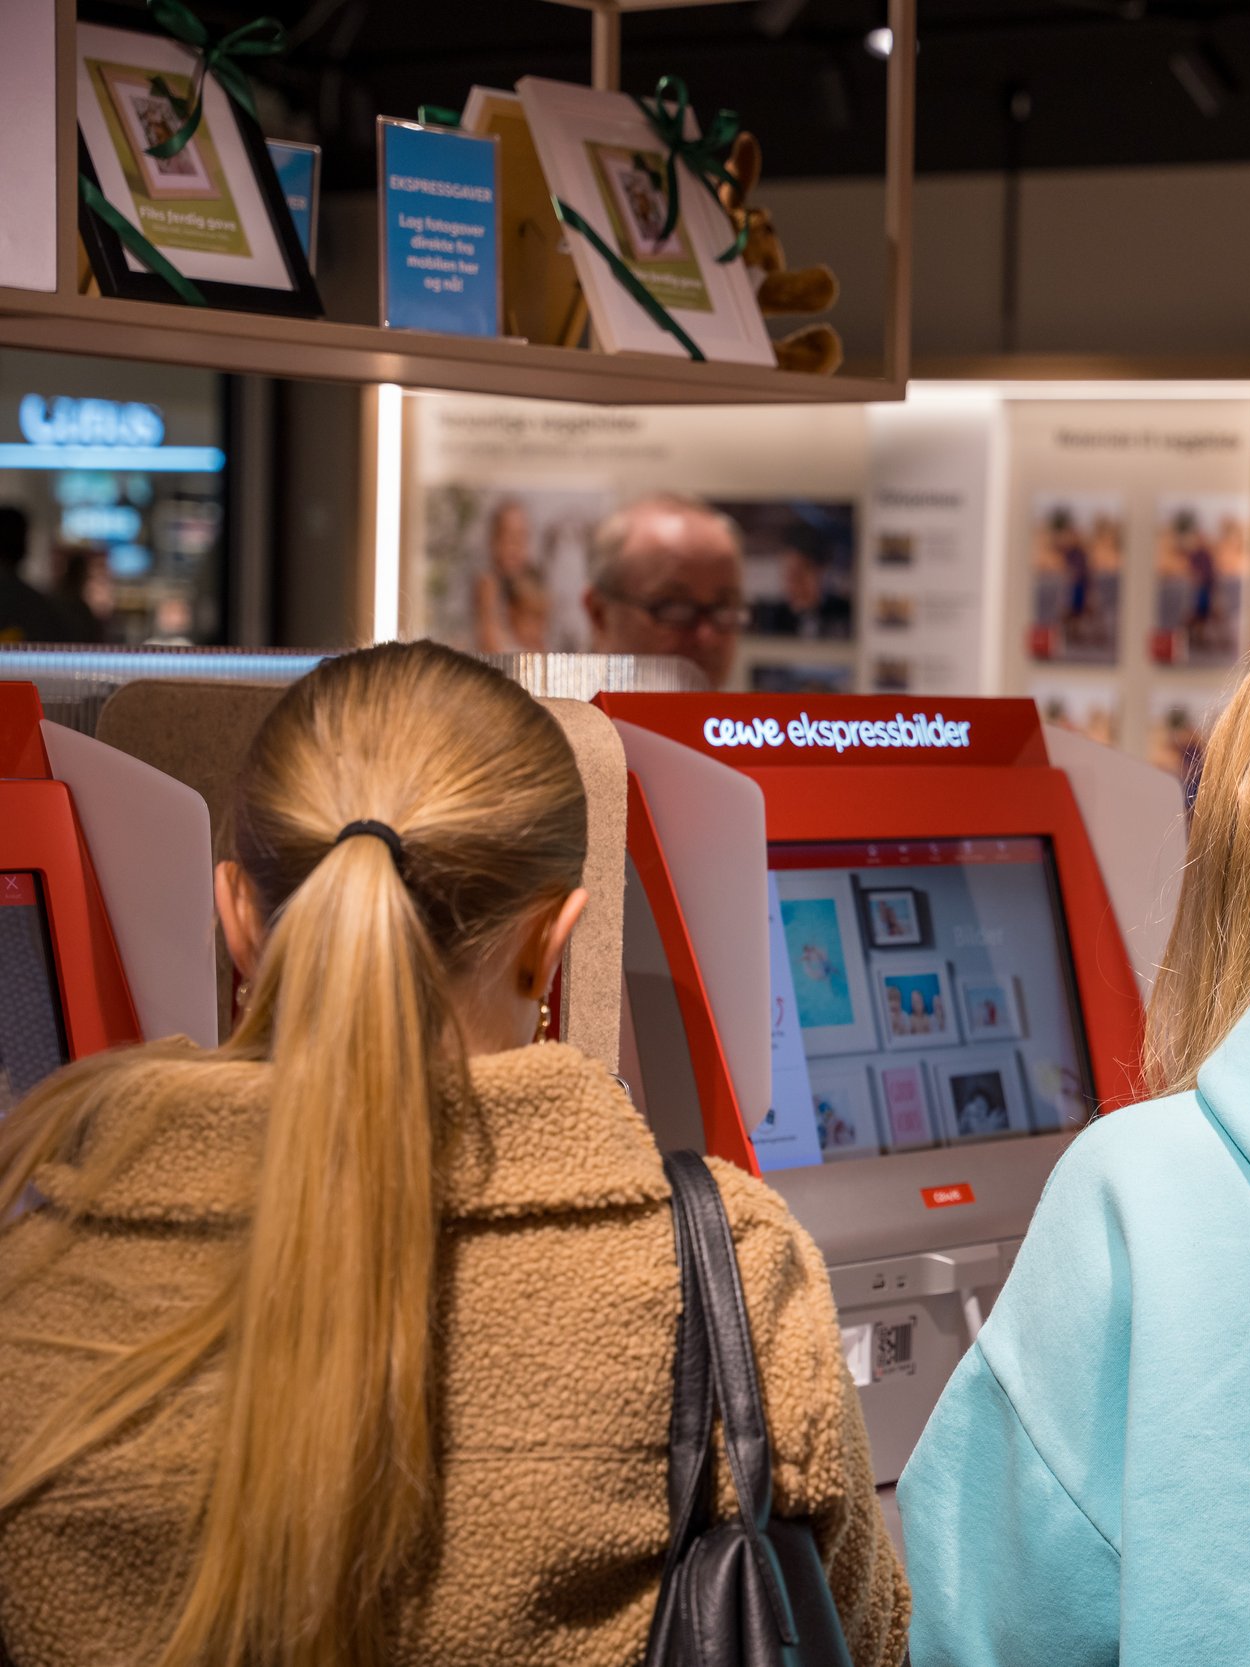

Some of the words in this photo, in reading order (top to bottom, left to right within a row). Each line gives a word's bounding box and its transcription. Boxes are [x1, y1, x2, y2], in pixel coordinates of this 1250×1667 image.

[389, 174, 493, 203] EKSPRESSGAVER
[399, 212, 423, 233] Lag
[425, 216, 486, 238] fotogaver
[410, 234, 454, 254] direkte
[456, 238, 475, 256] fra
[406, 255, 457, 272] mobilen
[458, 259, 479, 275] her
[423, 276, 441, 293] og
[703, 717, 786, 748] cewe
[787, 712, 971, 753] ekspressbilder
